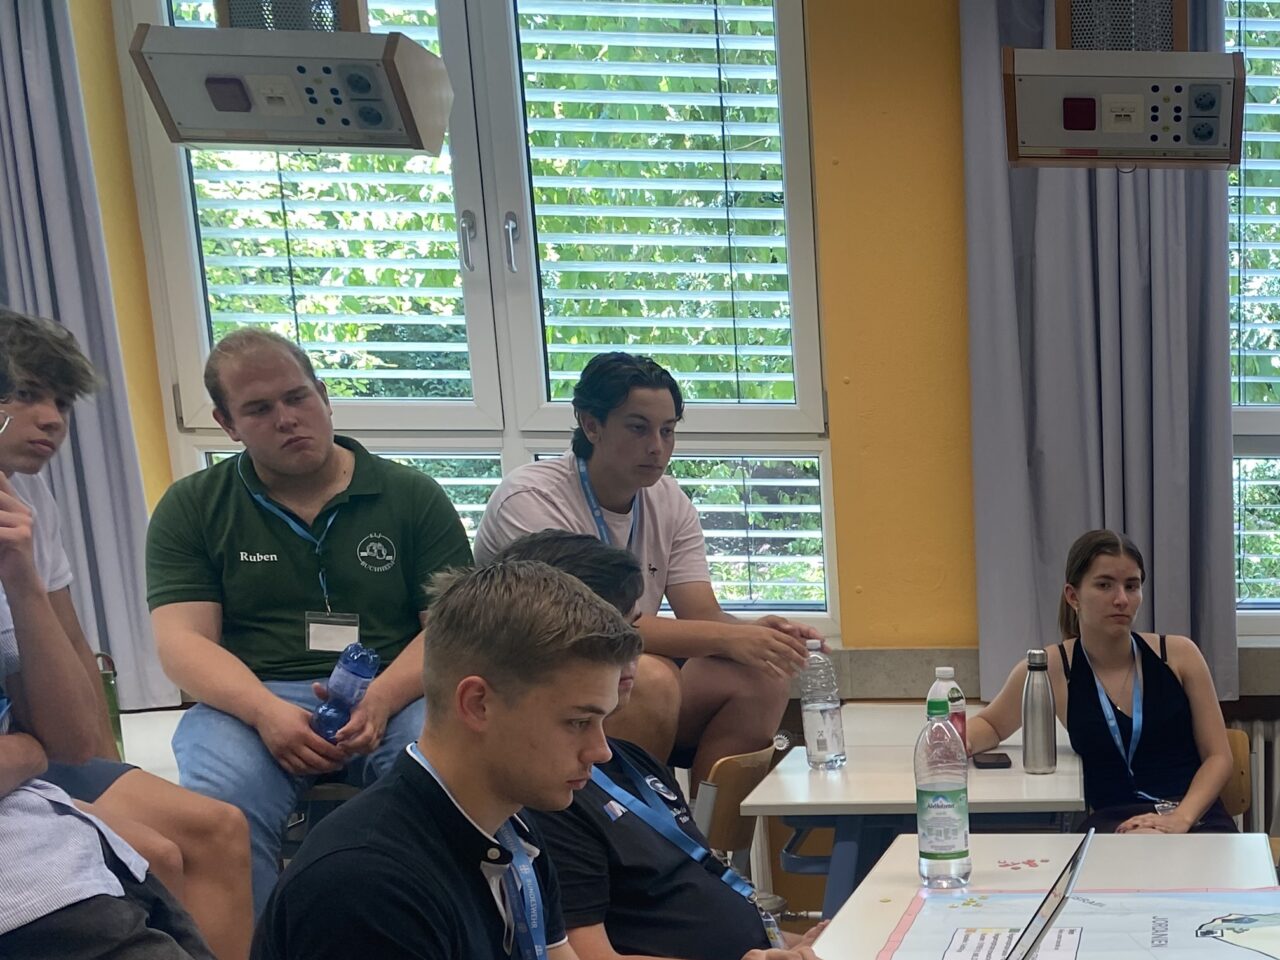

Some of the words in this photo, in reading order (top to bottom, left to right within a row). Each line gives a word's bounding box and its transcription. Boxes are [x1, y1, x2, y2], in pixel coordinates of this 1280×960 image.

[240, 551, 278, 562] Ruben
[528, 879, 539, 929] BUNDESWEHR
[1152, 916, 1169, 948] JORDANIEN
